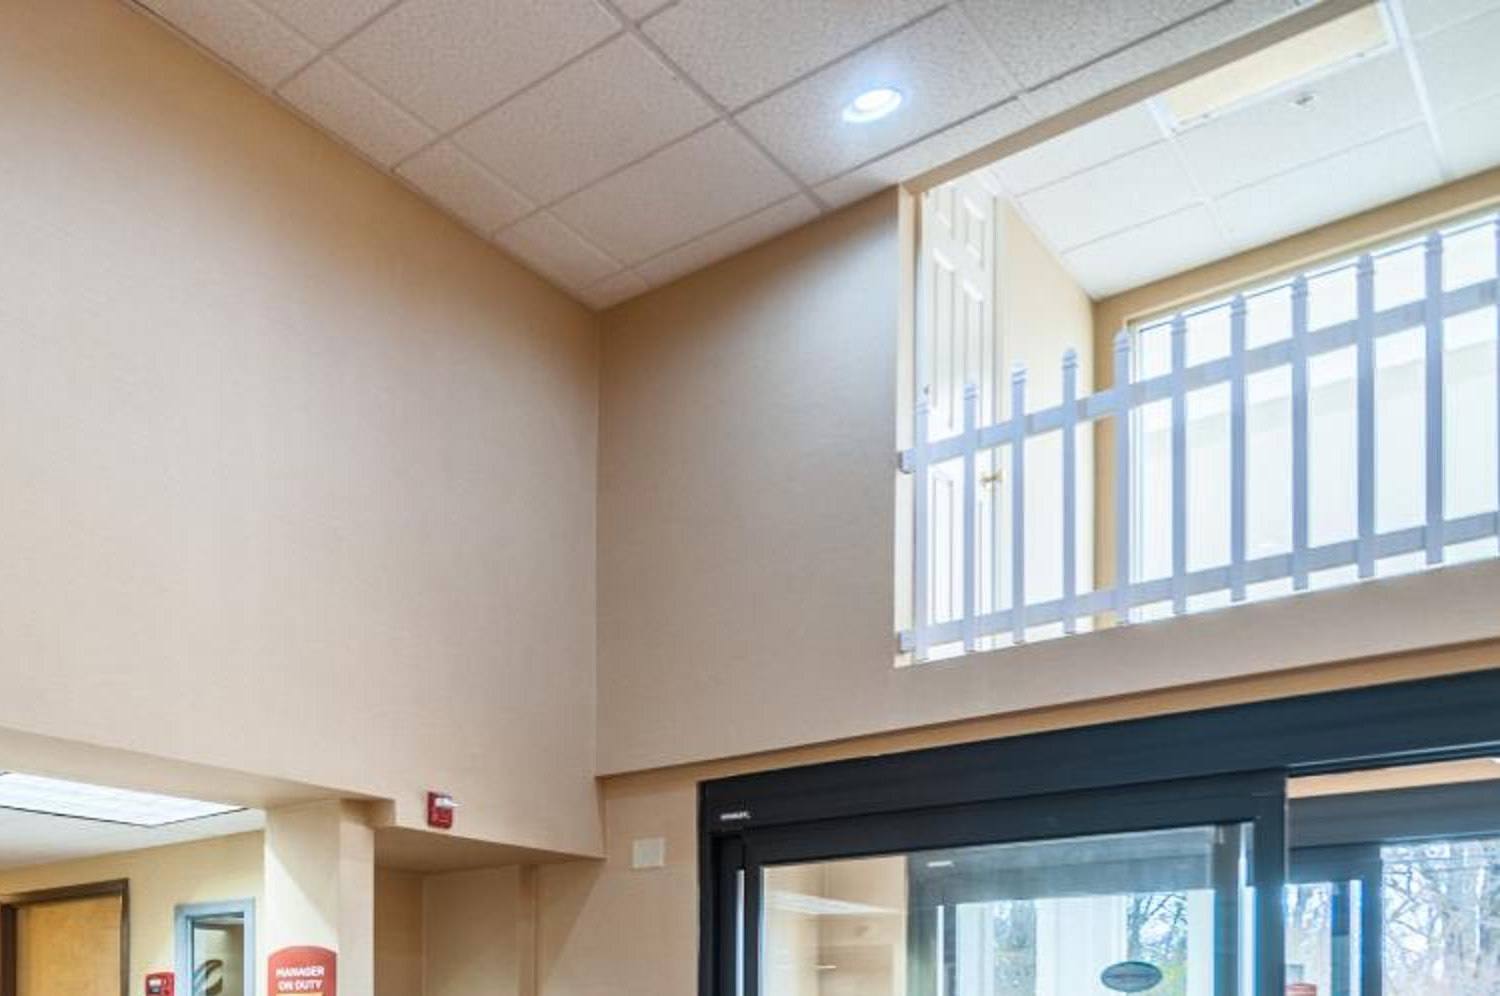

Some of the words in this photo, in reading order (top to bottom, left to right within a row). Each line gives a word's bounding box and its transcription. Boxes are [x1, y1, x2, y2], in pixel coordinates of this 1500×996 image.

[275, 965, 325, 979] MANAGER
[277, 979, 293, 992] ON
[295, 979, 324, 991] DUTY
